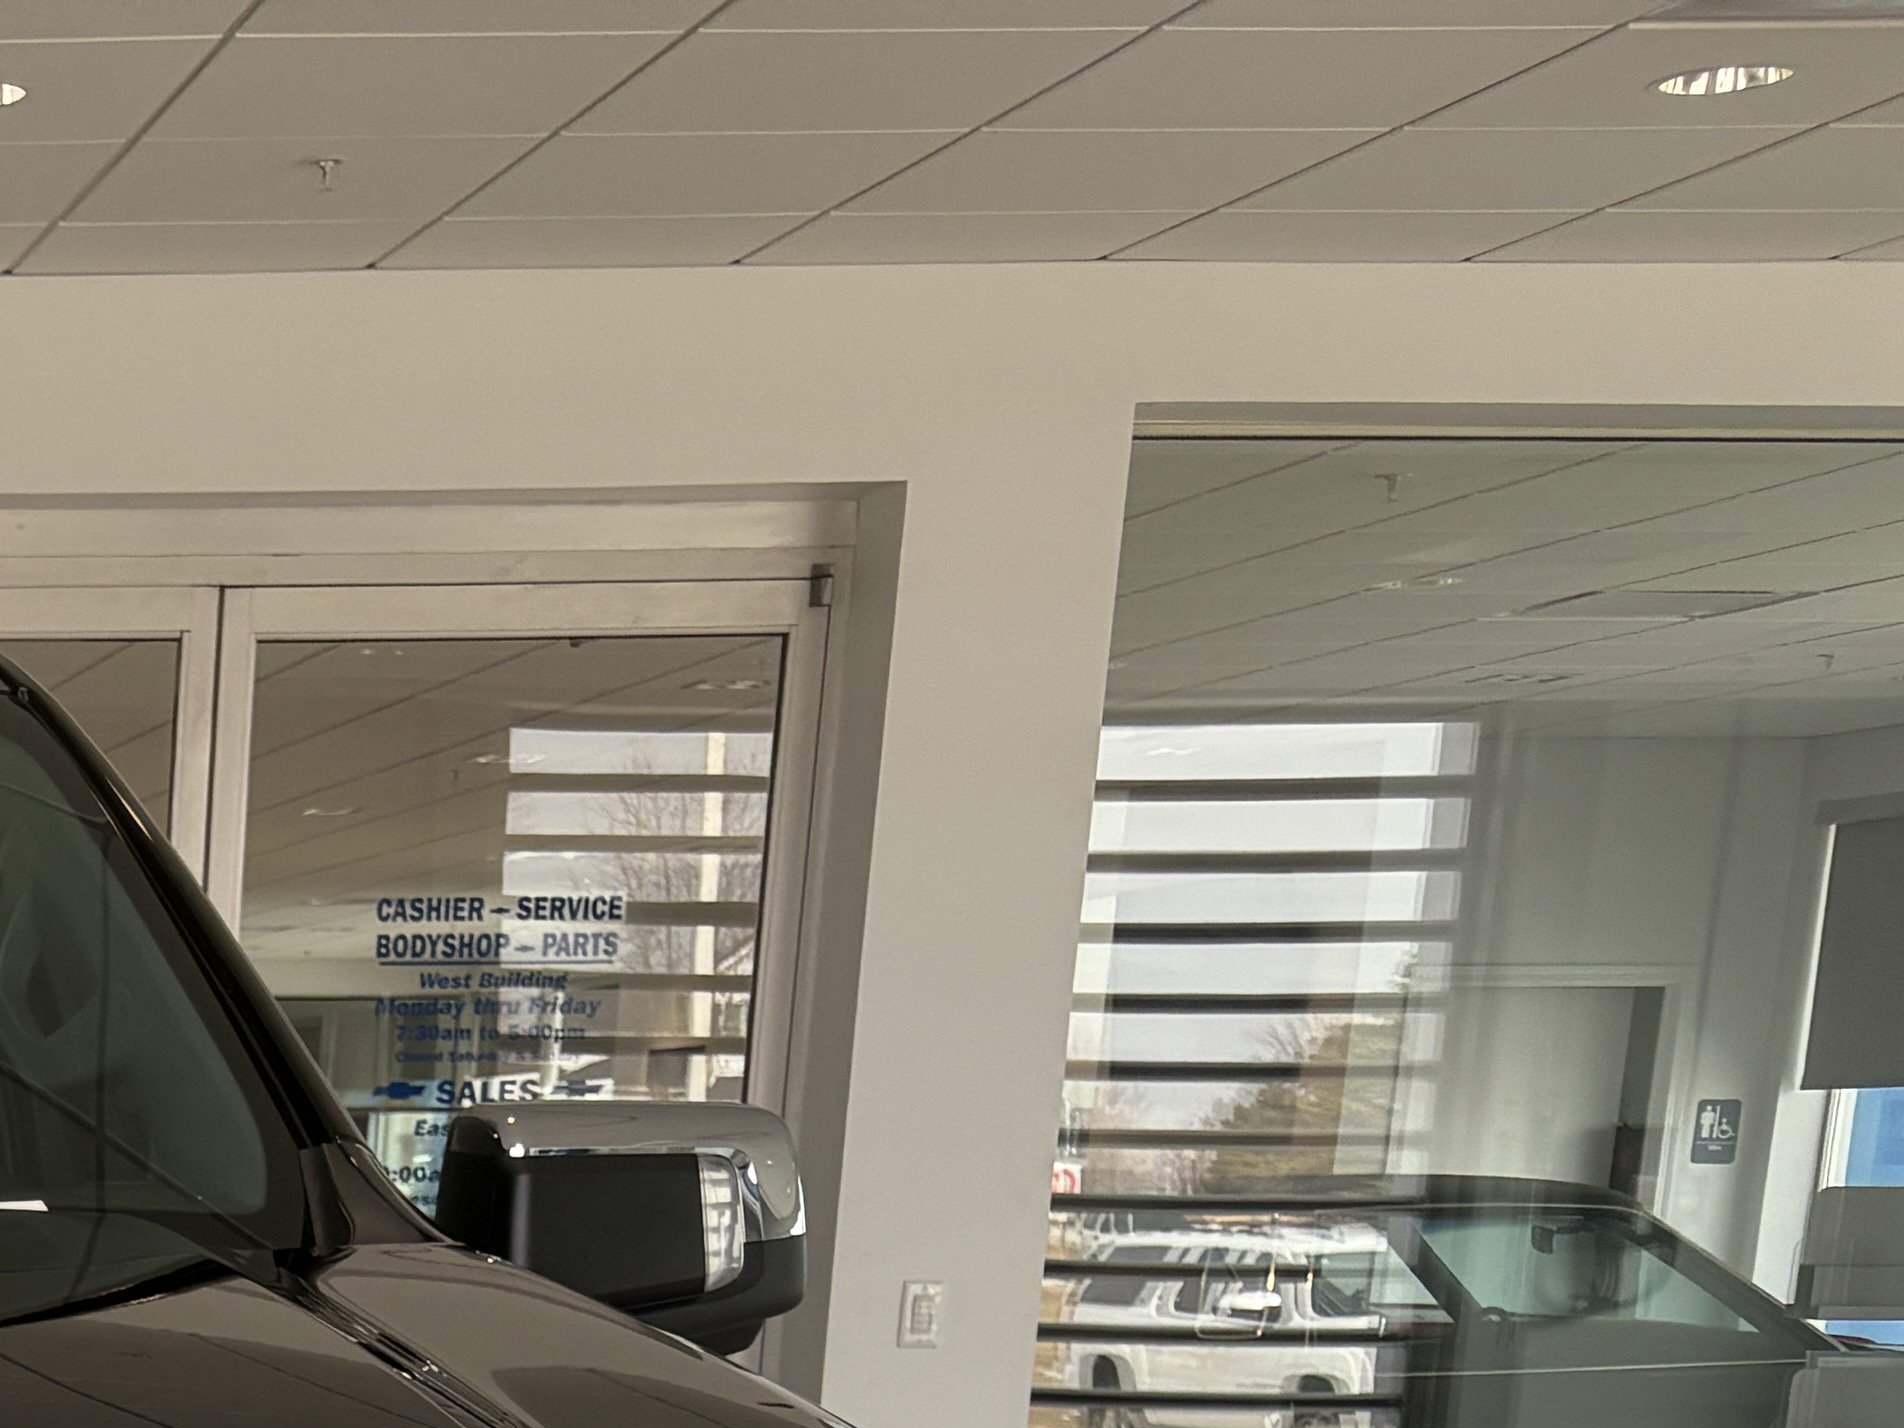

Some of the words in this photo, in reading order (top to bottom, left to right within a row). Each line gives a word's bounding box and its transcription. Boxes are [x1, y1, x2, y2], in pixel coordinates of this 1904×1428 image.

[376, 898, 485, 922] CASHIER
[516, 896, 623, 921] SERVICE
[376, 933, 510, 958] BODYSHOP
[542, 932, 618, 957] PARTS
[419, 972, 472, 989] West
[479, 971, 569, 991] Building
[375, 997, 465, 1018] Monday
[529, 996, 601, 1019] Friday
[437, 1079, 541, 1105] SALES
[414, 1119, 450, 1137] Eas
